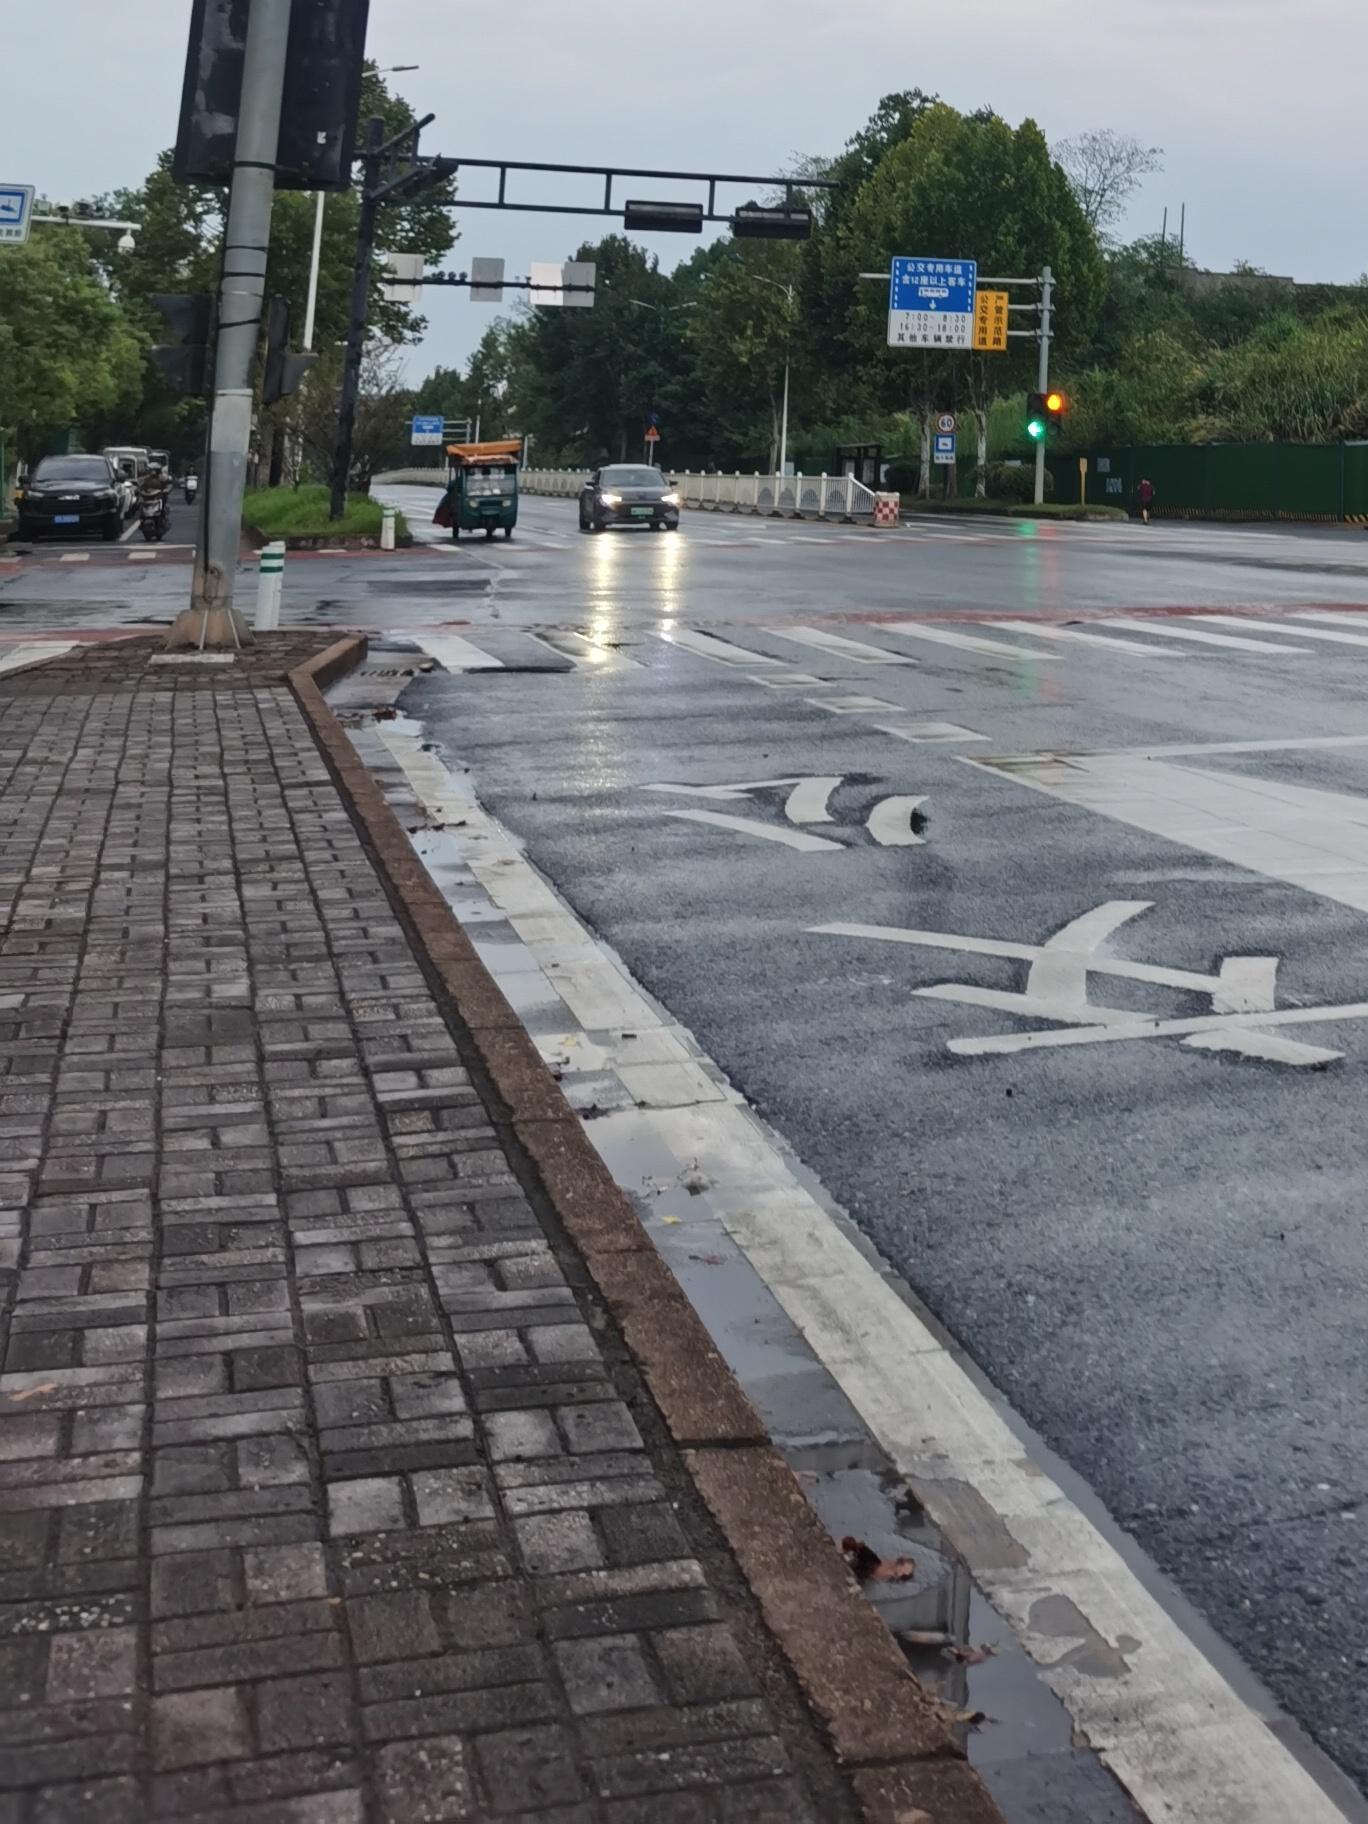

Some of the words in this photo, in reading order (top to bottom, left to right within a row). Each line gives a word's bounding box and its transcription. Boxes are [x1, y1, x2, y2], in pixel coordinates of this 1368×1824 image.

[907, 262, 962, 276] 公交专用车道
